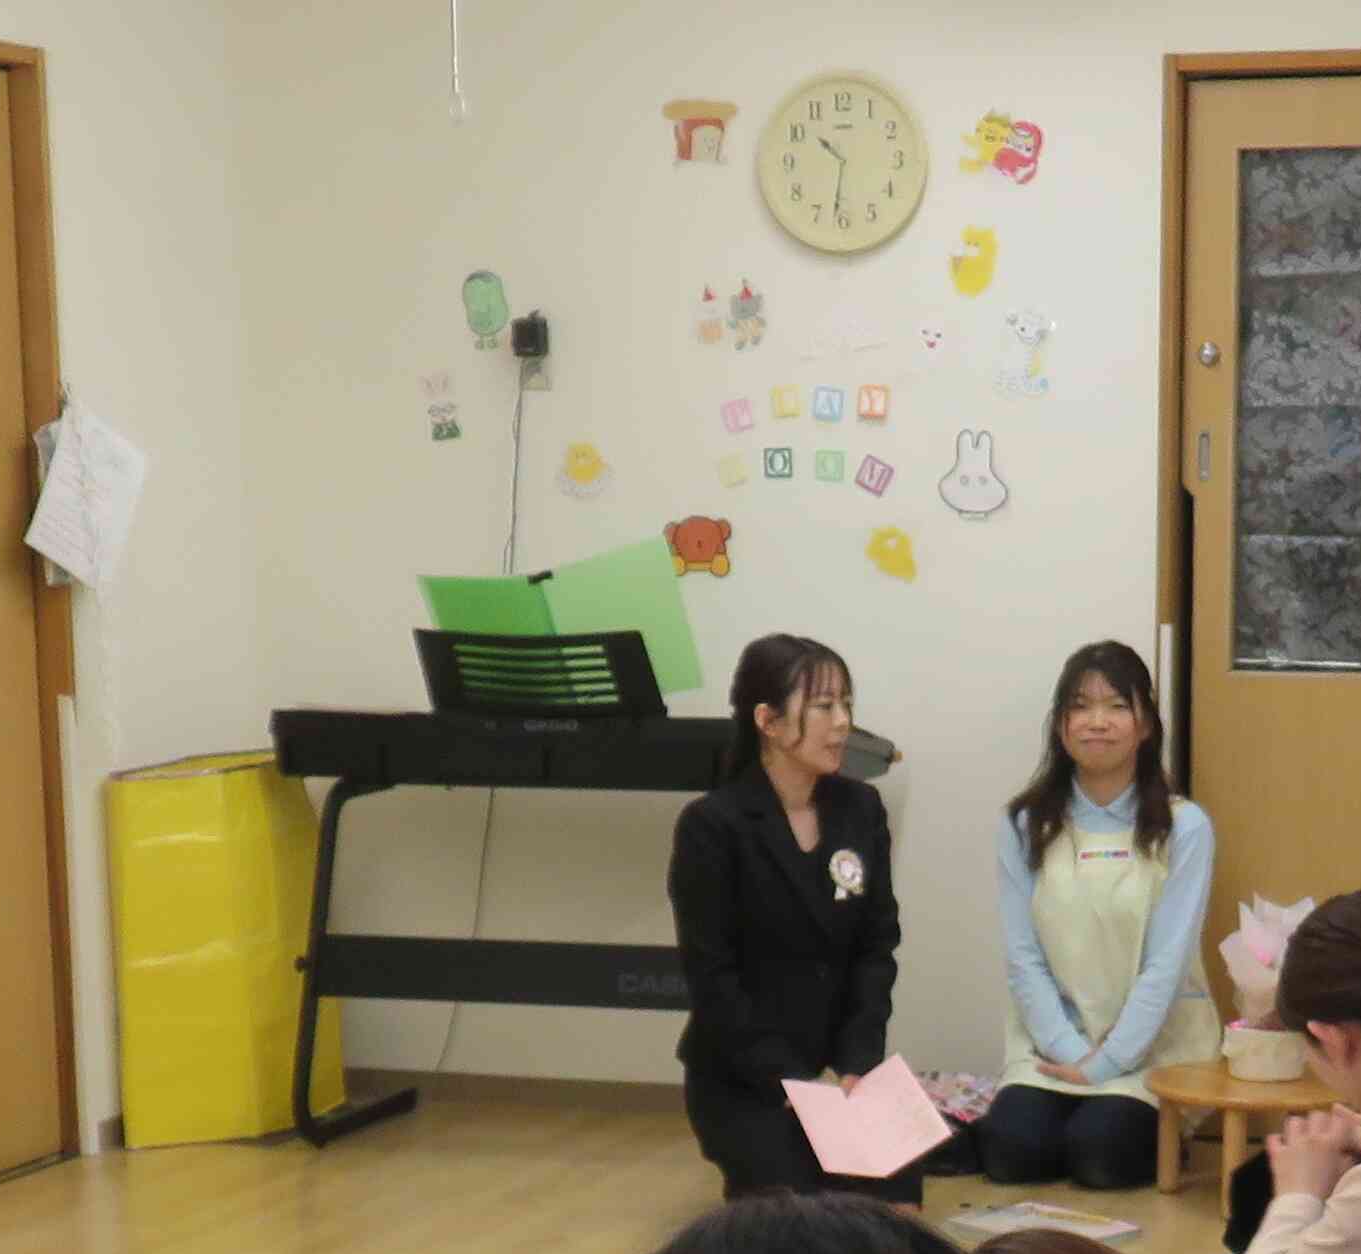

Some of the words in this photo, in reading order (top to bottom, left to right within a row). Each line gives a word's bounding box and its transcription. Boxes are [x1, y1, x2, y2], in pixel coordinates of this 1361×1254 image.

[809, 100, 821, 120] 11
[833, 91, 852, 112] 12
[866, 99, 872, 119] 1
[790, 122, 805, 142] 10
[885, 120, 896, 140] 2
[782, 152, 794, 173] 9
[893, 150, 904, 170] 3
[791, 183, 802, 202] 8
[882, 178, 893, 198] 4
[810, 203, 821, 223] 7
[837, 210, 849, 230] 6
[866, 203, 877, 222] 5
